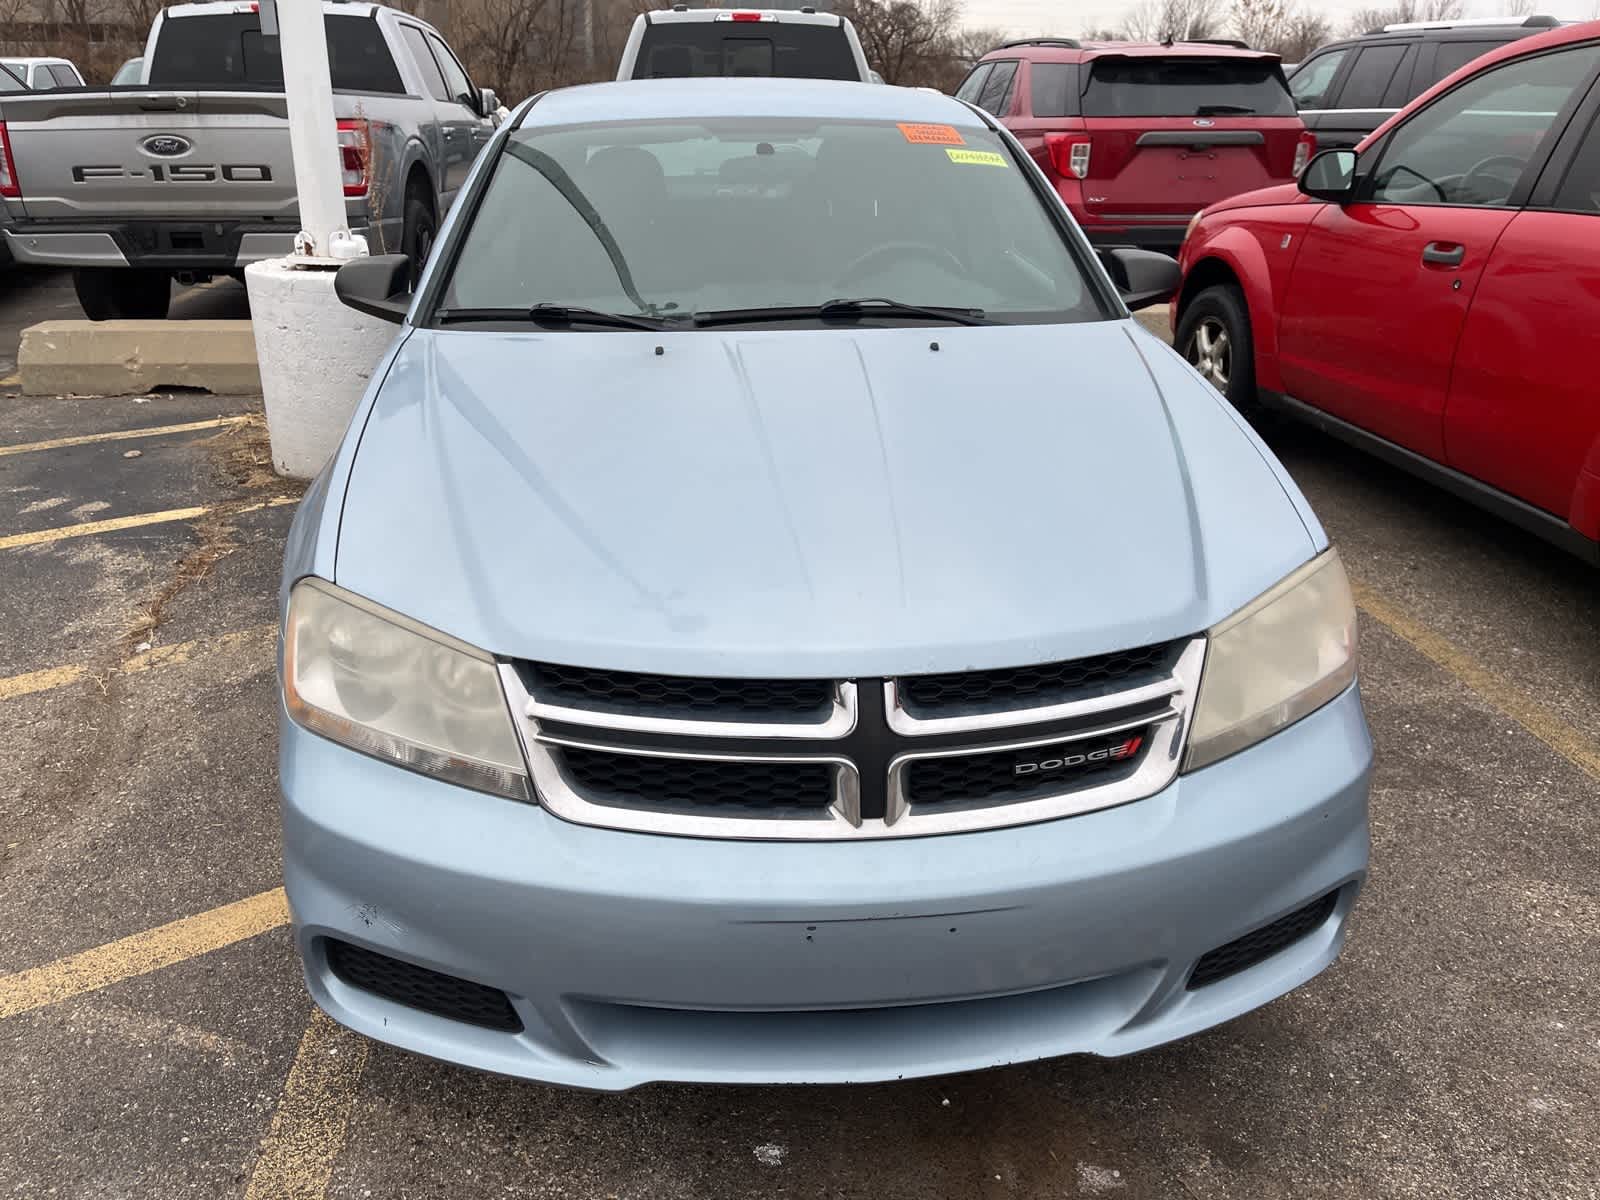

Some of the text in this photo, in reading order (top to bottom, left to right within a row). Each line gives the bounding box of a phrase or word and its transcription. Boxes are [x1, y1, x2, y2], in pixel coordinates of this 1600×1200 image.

[153, 140, 178, 151] Ford
[71, 165, 274, 184] F-150
[1015, 744, 1129, 774] DODGE
